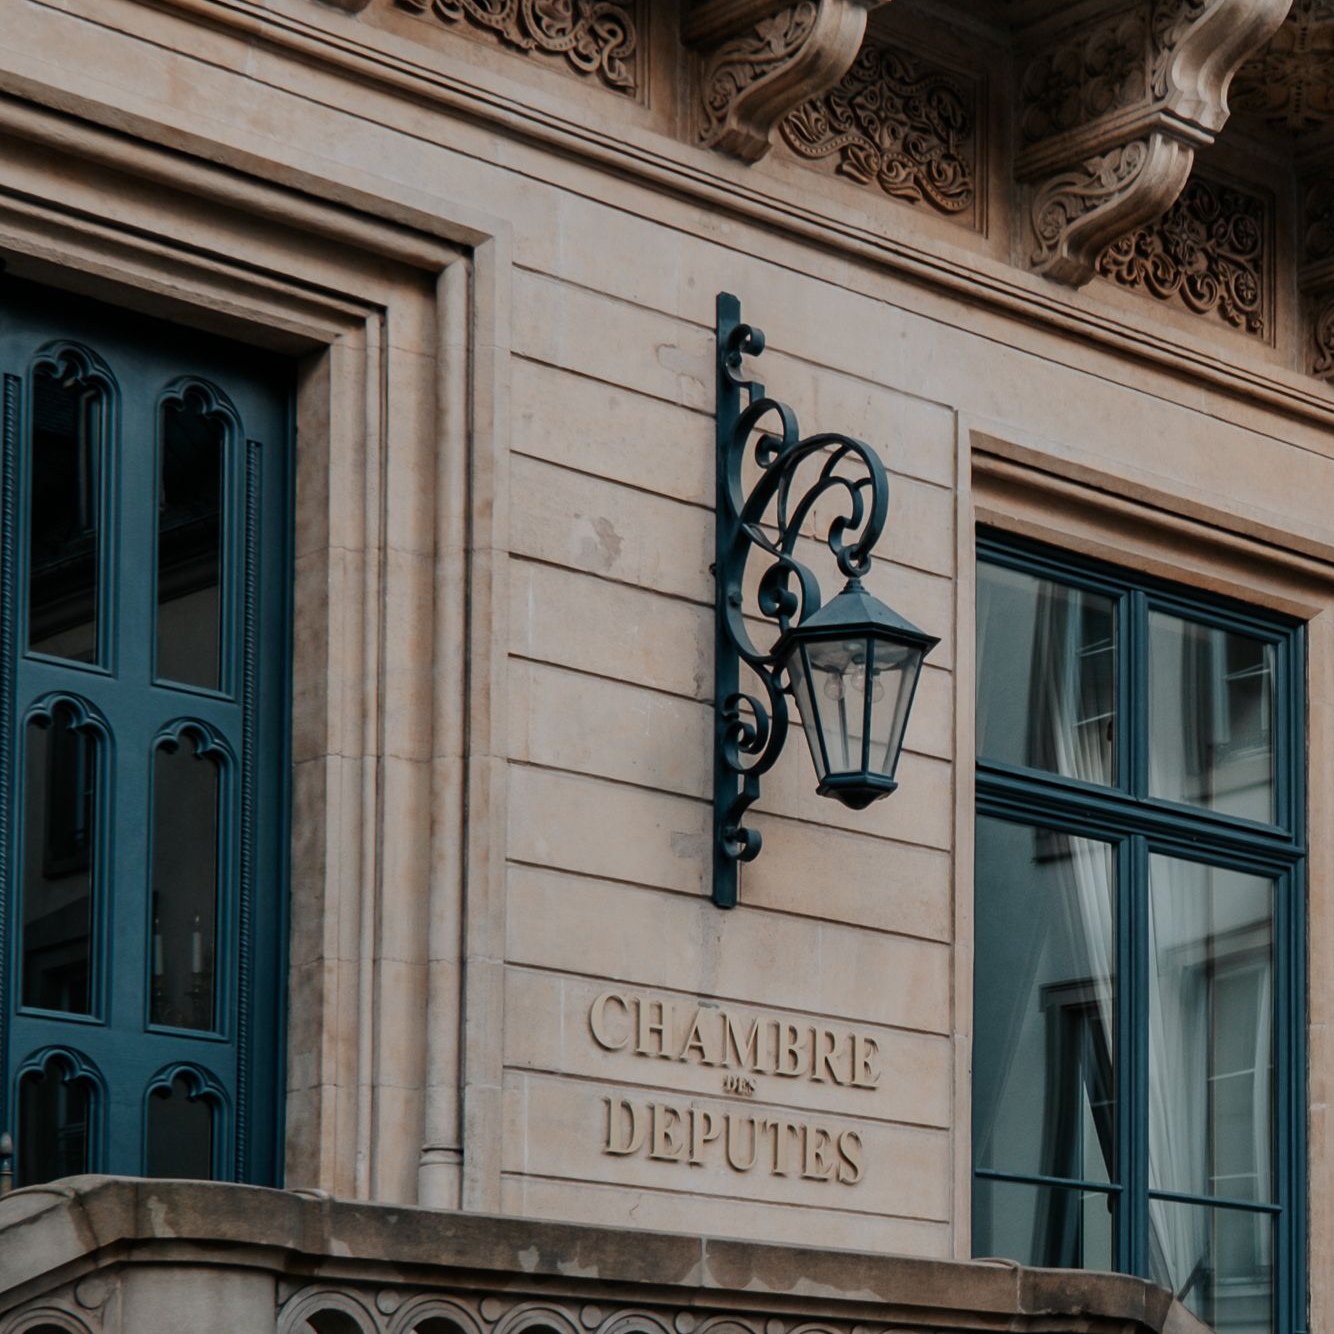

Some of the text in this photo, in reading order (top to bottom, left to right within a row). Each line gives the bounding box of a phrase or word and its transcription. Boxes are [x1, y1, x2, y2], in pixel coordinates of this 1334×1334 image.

[588, 993, 881, 1090] CHAMBRE
[723, 1074, 755, 1096] DES
[601, 1096, 864, 1185] DEPUTES
